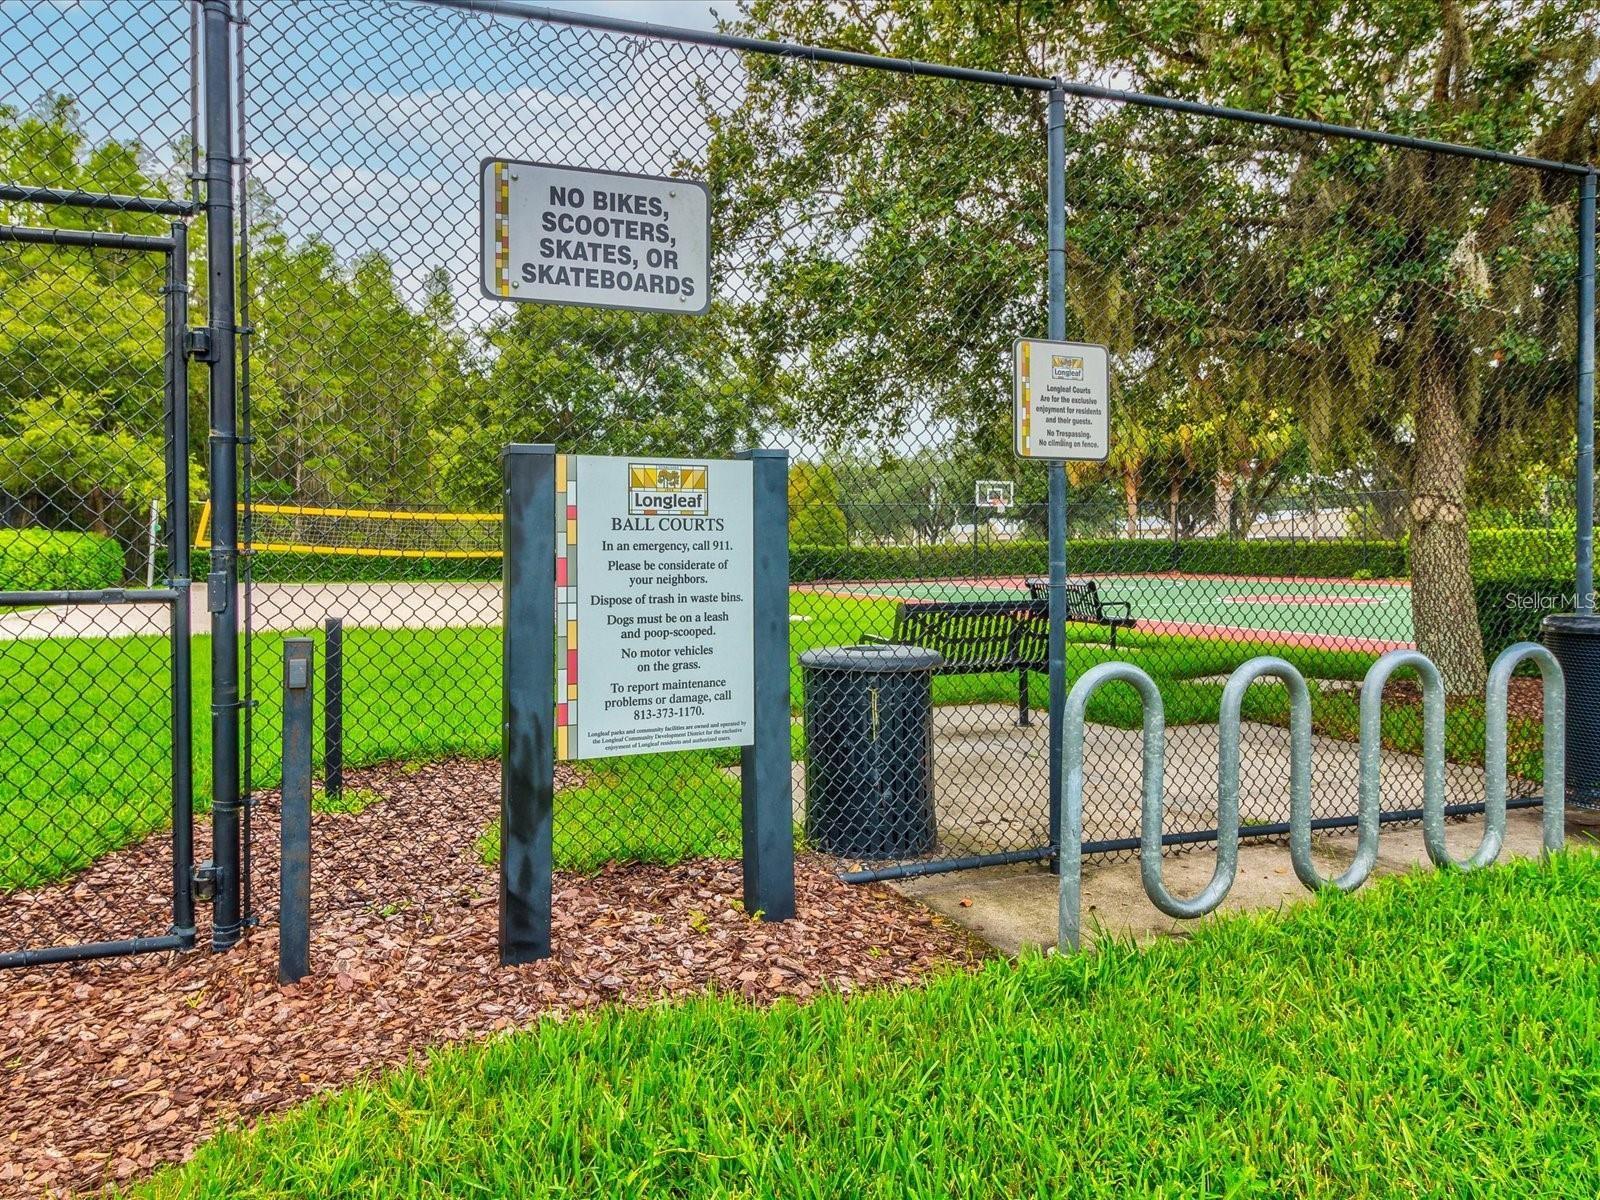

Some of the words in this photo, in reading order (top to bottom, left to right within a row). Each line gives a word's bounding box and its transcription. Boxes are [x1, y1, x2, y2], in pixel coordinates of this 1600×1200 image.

[550, 186, 584, 208] NO
[593, 190, 669, 221] BIKES,
[542, 211, 676, 248] SCOOTERS,
[539, 238, 639, 270] SKATES,
[646, 248, 678, 270] OR
[521, 262, 695, 297] SKATEBOARDS
[1054, 368, 1081, 377] Longleaf
[1046, 384, 1071, 394] Longleaf
[1040, 394, 1050, 403] Are
[1071, 397, 1097, 405] exclusive
[1036, 405, 1066, 414] enjoyment
[1076, 407, 1102, 416] residents
[1072, 418, 1092, 426] guests.
[1047, 429, 1054, 437] No
[1048, 440, 1072, 448] climbing
[635, 493, 702, 509] Longleaf
[611, 518, 654, 531] BALL
[658, 518, 725, 532] COURTS
[602, 541, 614, 551] In
[616, 543, 629, 551] an
[633, 543, 690, 553] emergency,
[692, 541, 710, 551] call
[712, 541, 733, 551] 911.
[608, 560, 641, 571] Please
[644, 560, 656, 570] be
[658, 560, 715, 570] considerate
[718, 560, 728, 570] of
[629, 576, 653, 587] your
[656, 574, 708, 585] neighbors.
[590, 595, 632, 608] Dispose
[635, 594, 646, 605] of
[649, 594, 675, 604] trash
[678, 594, 687, 603] in
[690, 594, 718, 603] waste
[720, 592, 743, 602] bins.
[607, 614, 634, 628] Dogs
[637, 614, 662, 624] must
[665, 613, 677, 623] be
[680, 614, 692, 623] on
[704, 612, 729, 622] leash
[621, 629, 640, 639] and
[644, 626, 716, 641] poop-scooped.
[621, 649, 637, 659] No
[640, 648, 671, 658] motor
[674, 645, 713, 656] vehicles
[637, 664, 650, 672] on
[653, 661, 669, 671] the
[672, 661, 701, 673] grass.
[610, 683, 624, 694] To
[627, 682, 659, 695] report
[662, 678, 726, 691] maintenance
[604, 693, 653, 710] problems
[655, 696, 667, 704] or
[669, 693, 712, 706] damage,
[714, 691, 732, 701] call
[634, 706, 704, 720] 813-373-1170.
